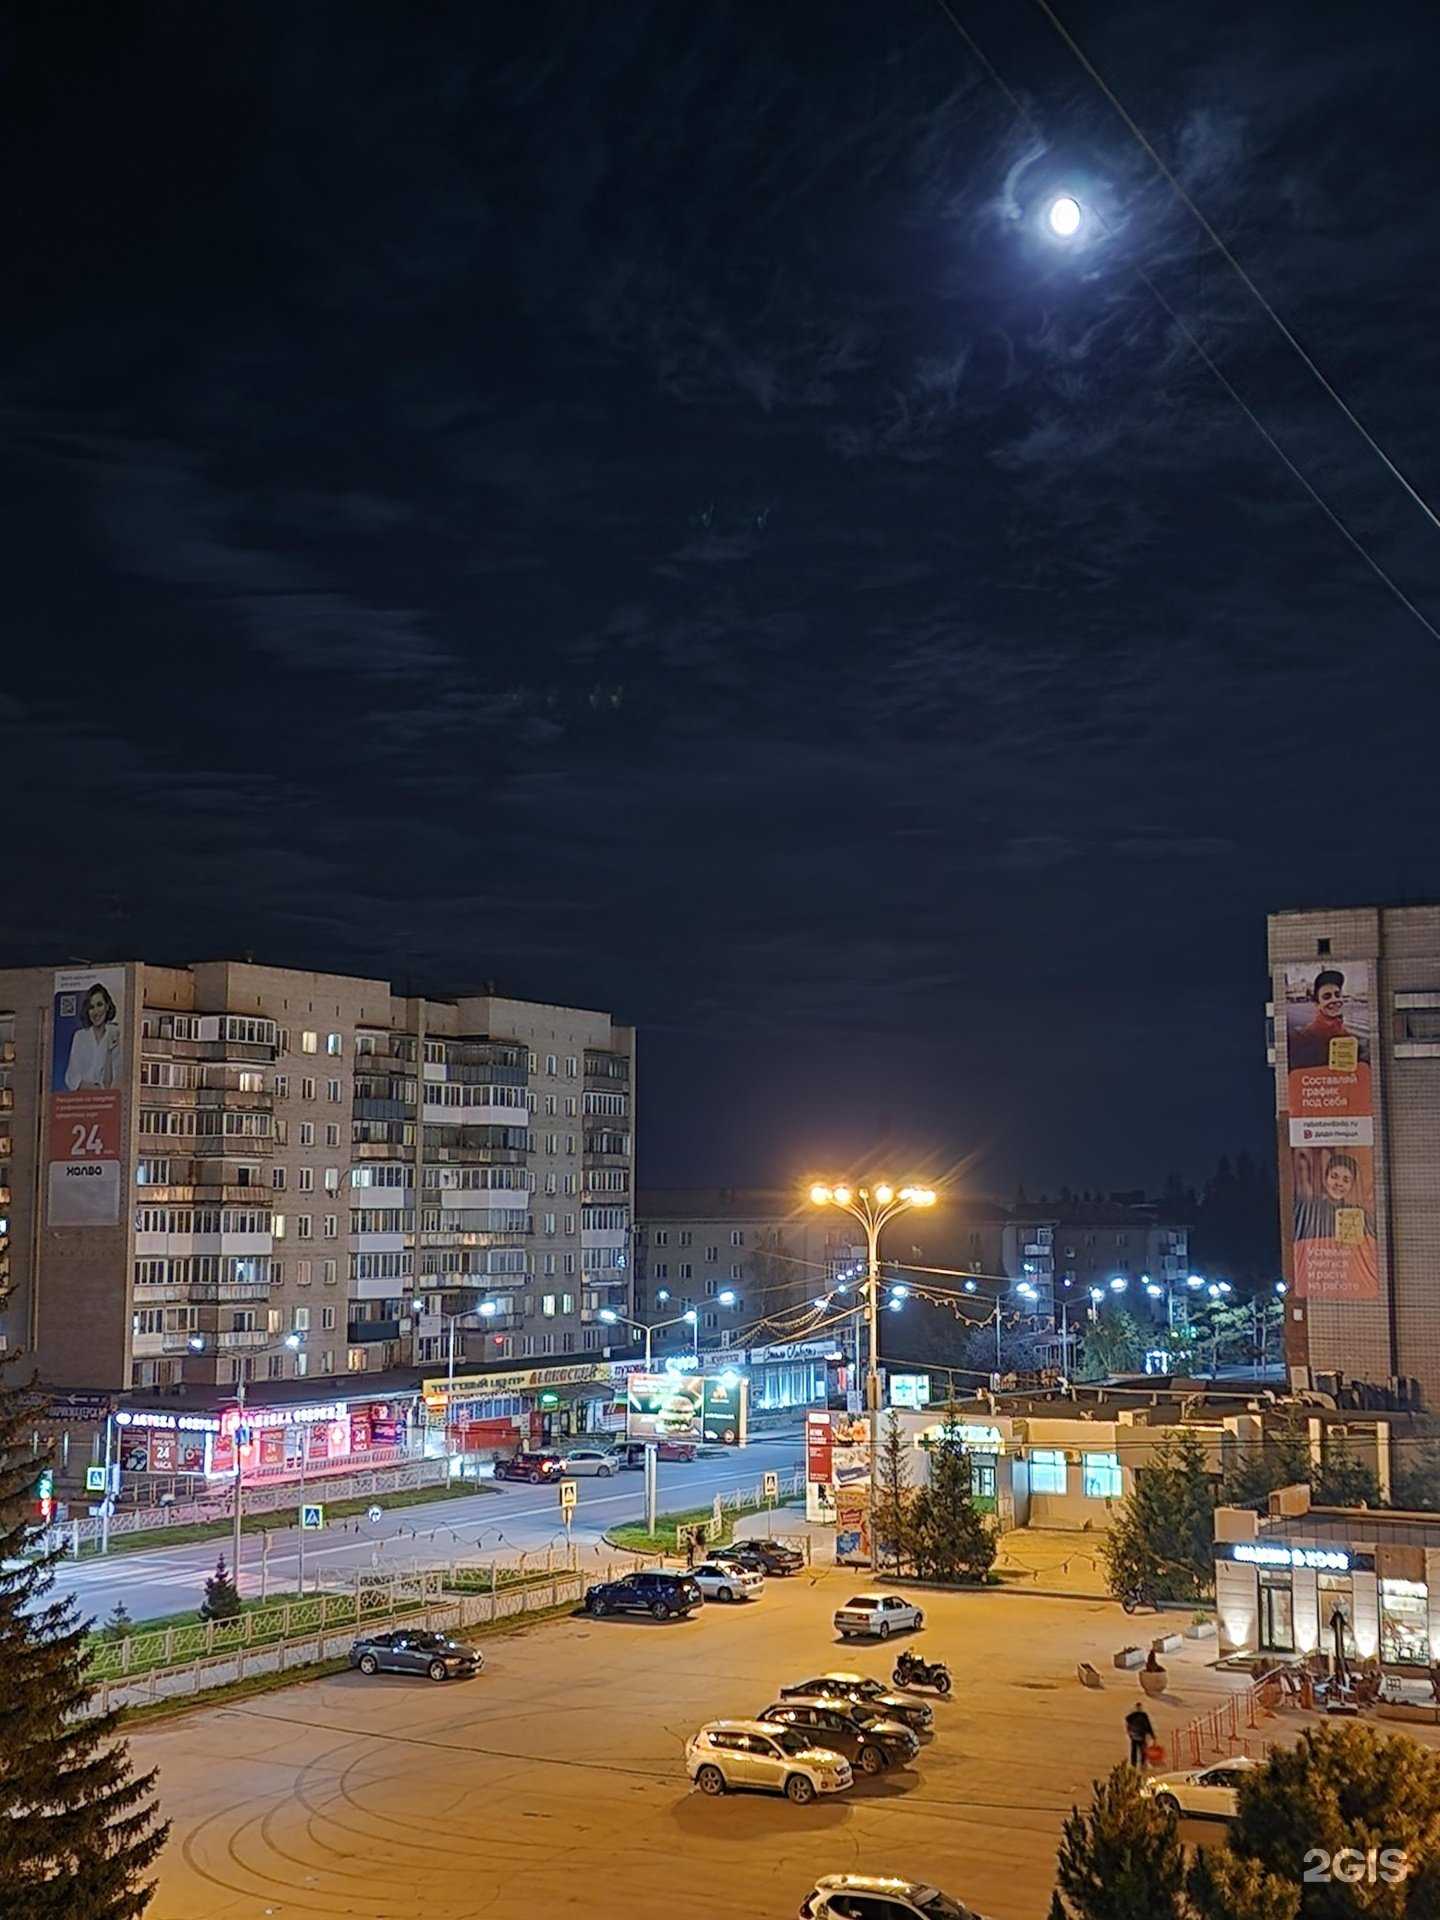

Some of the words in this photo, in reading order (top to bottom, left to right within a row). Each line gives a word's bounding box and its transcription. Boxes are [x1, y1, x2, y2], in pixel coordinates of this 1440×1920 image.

[1302, 1073, 1358, 1086] Составляй
[1302, 1086, 1340, 1097] график
[1302, 1098, 1322, 1108] под
[1323, 1096, 1348, 1107] себя
[71, 1124, 103, 1156] 24
[131, 1413, 176, 1429] АПТЕКА
[355, 1429, 366, 1442] 24
[156, 1446, 170, 1459] 24
